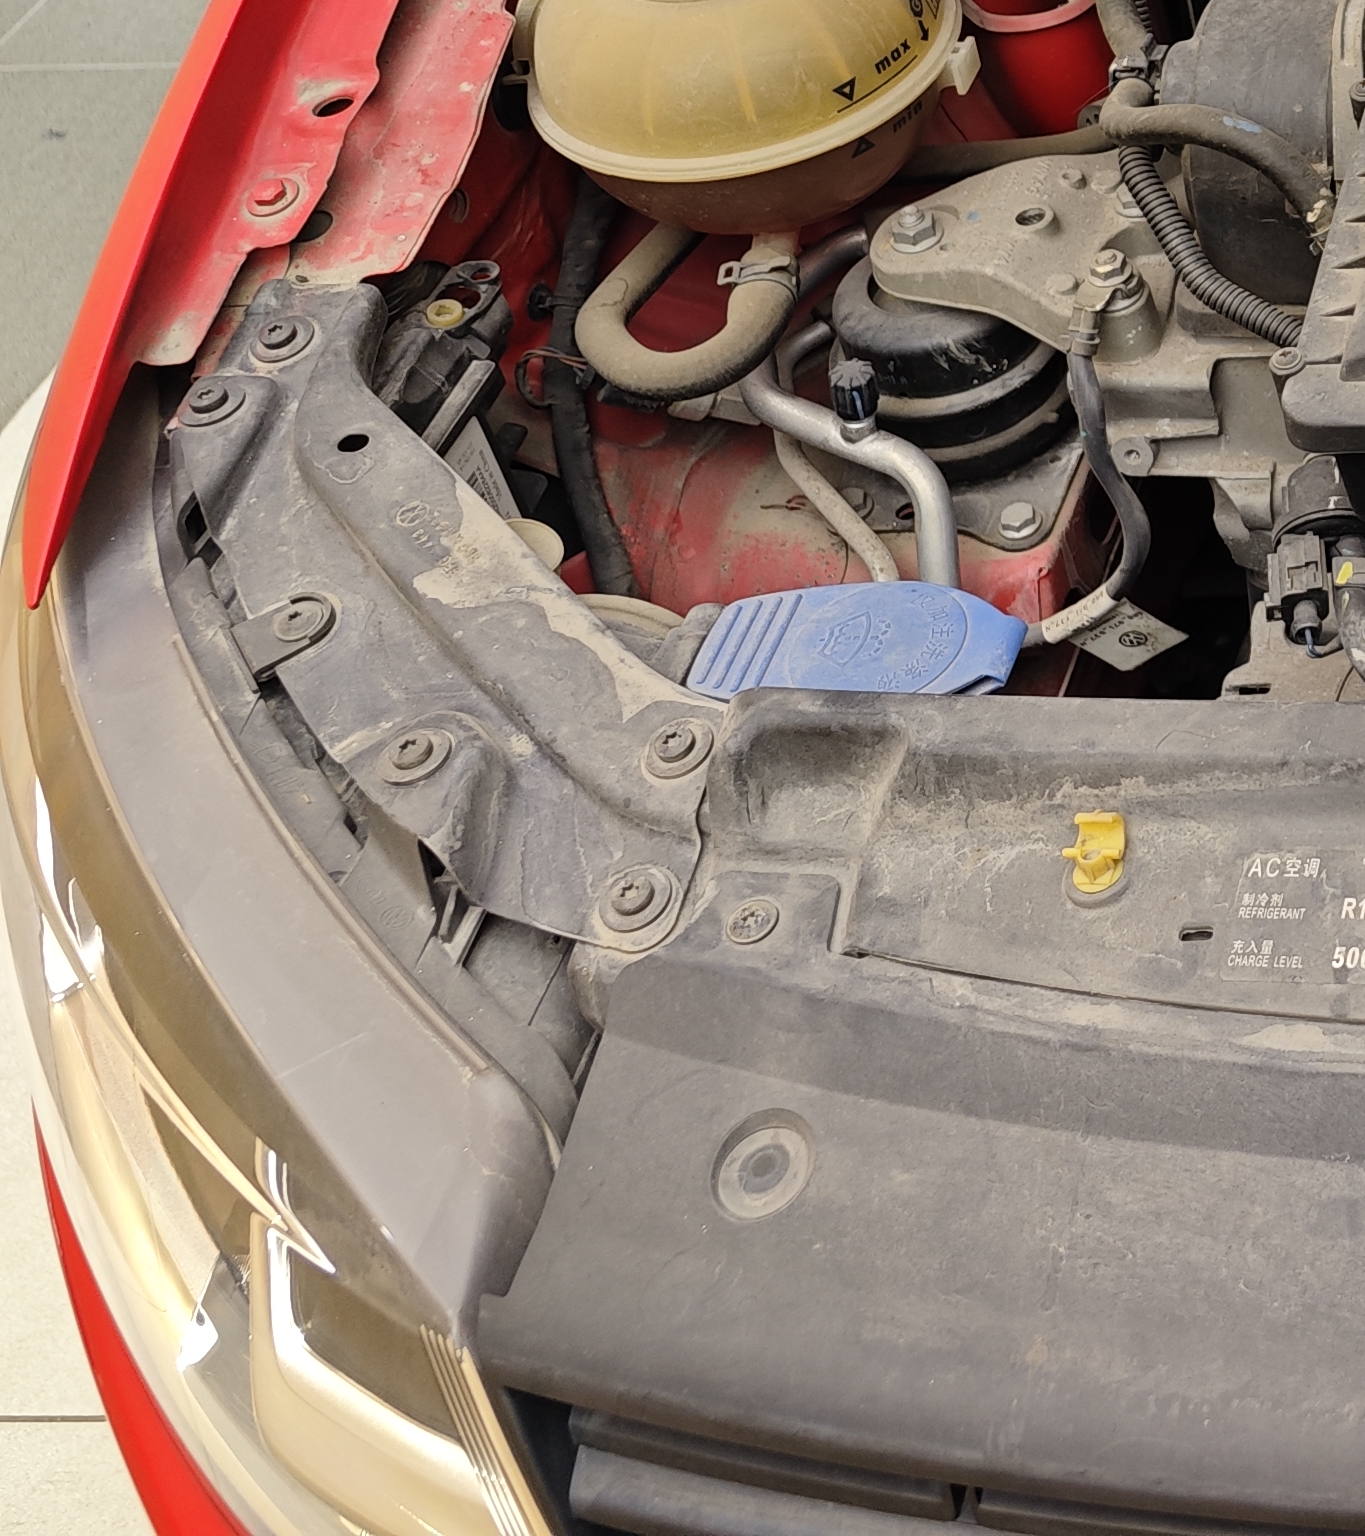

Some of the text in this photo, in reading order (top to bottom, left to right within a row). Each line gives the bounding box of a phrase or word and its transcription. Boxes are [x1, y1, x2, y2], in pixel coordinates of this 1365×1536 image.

[874, 38, 912, 75] max
[892, 99, 923, 134] min
[1241, 892, 1284, 907] 制冷剂
[1238, 907, 1306, 920] REFRIGERANT
[1231, 939, 1274, 955] 充入量
[1227, 954, 1303, 969] CHARGE LEVEL
